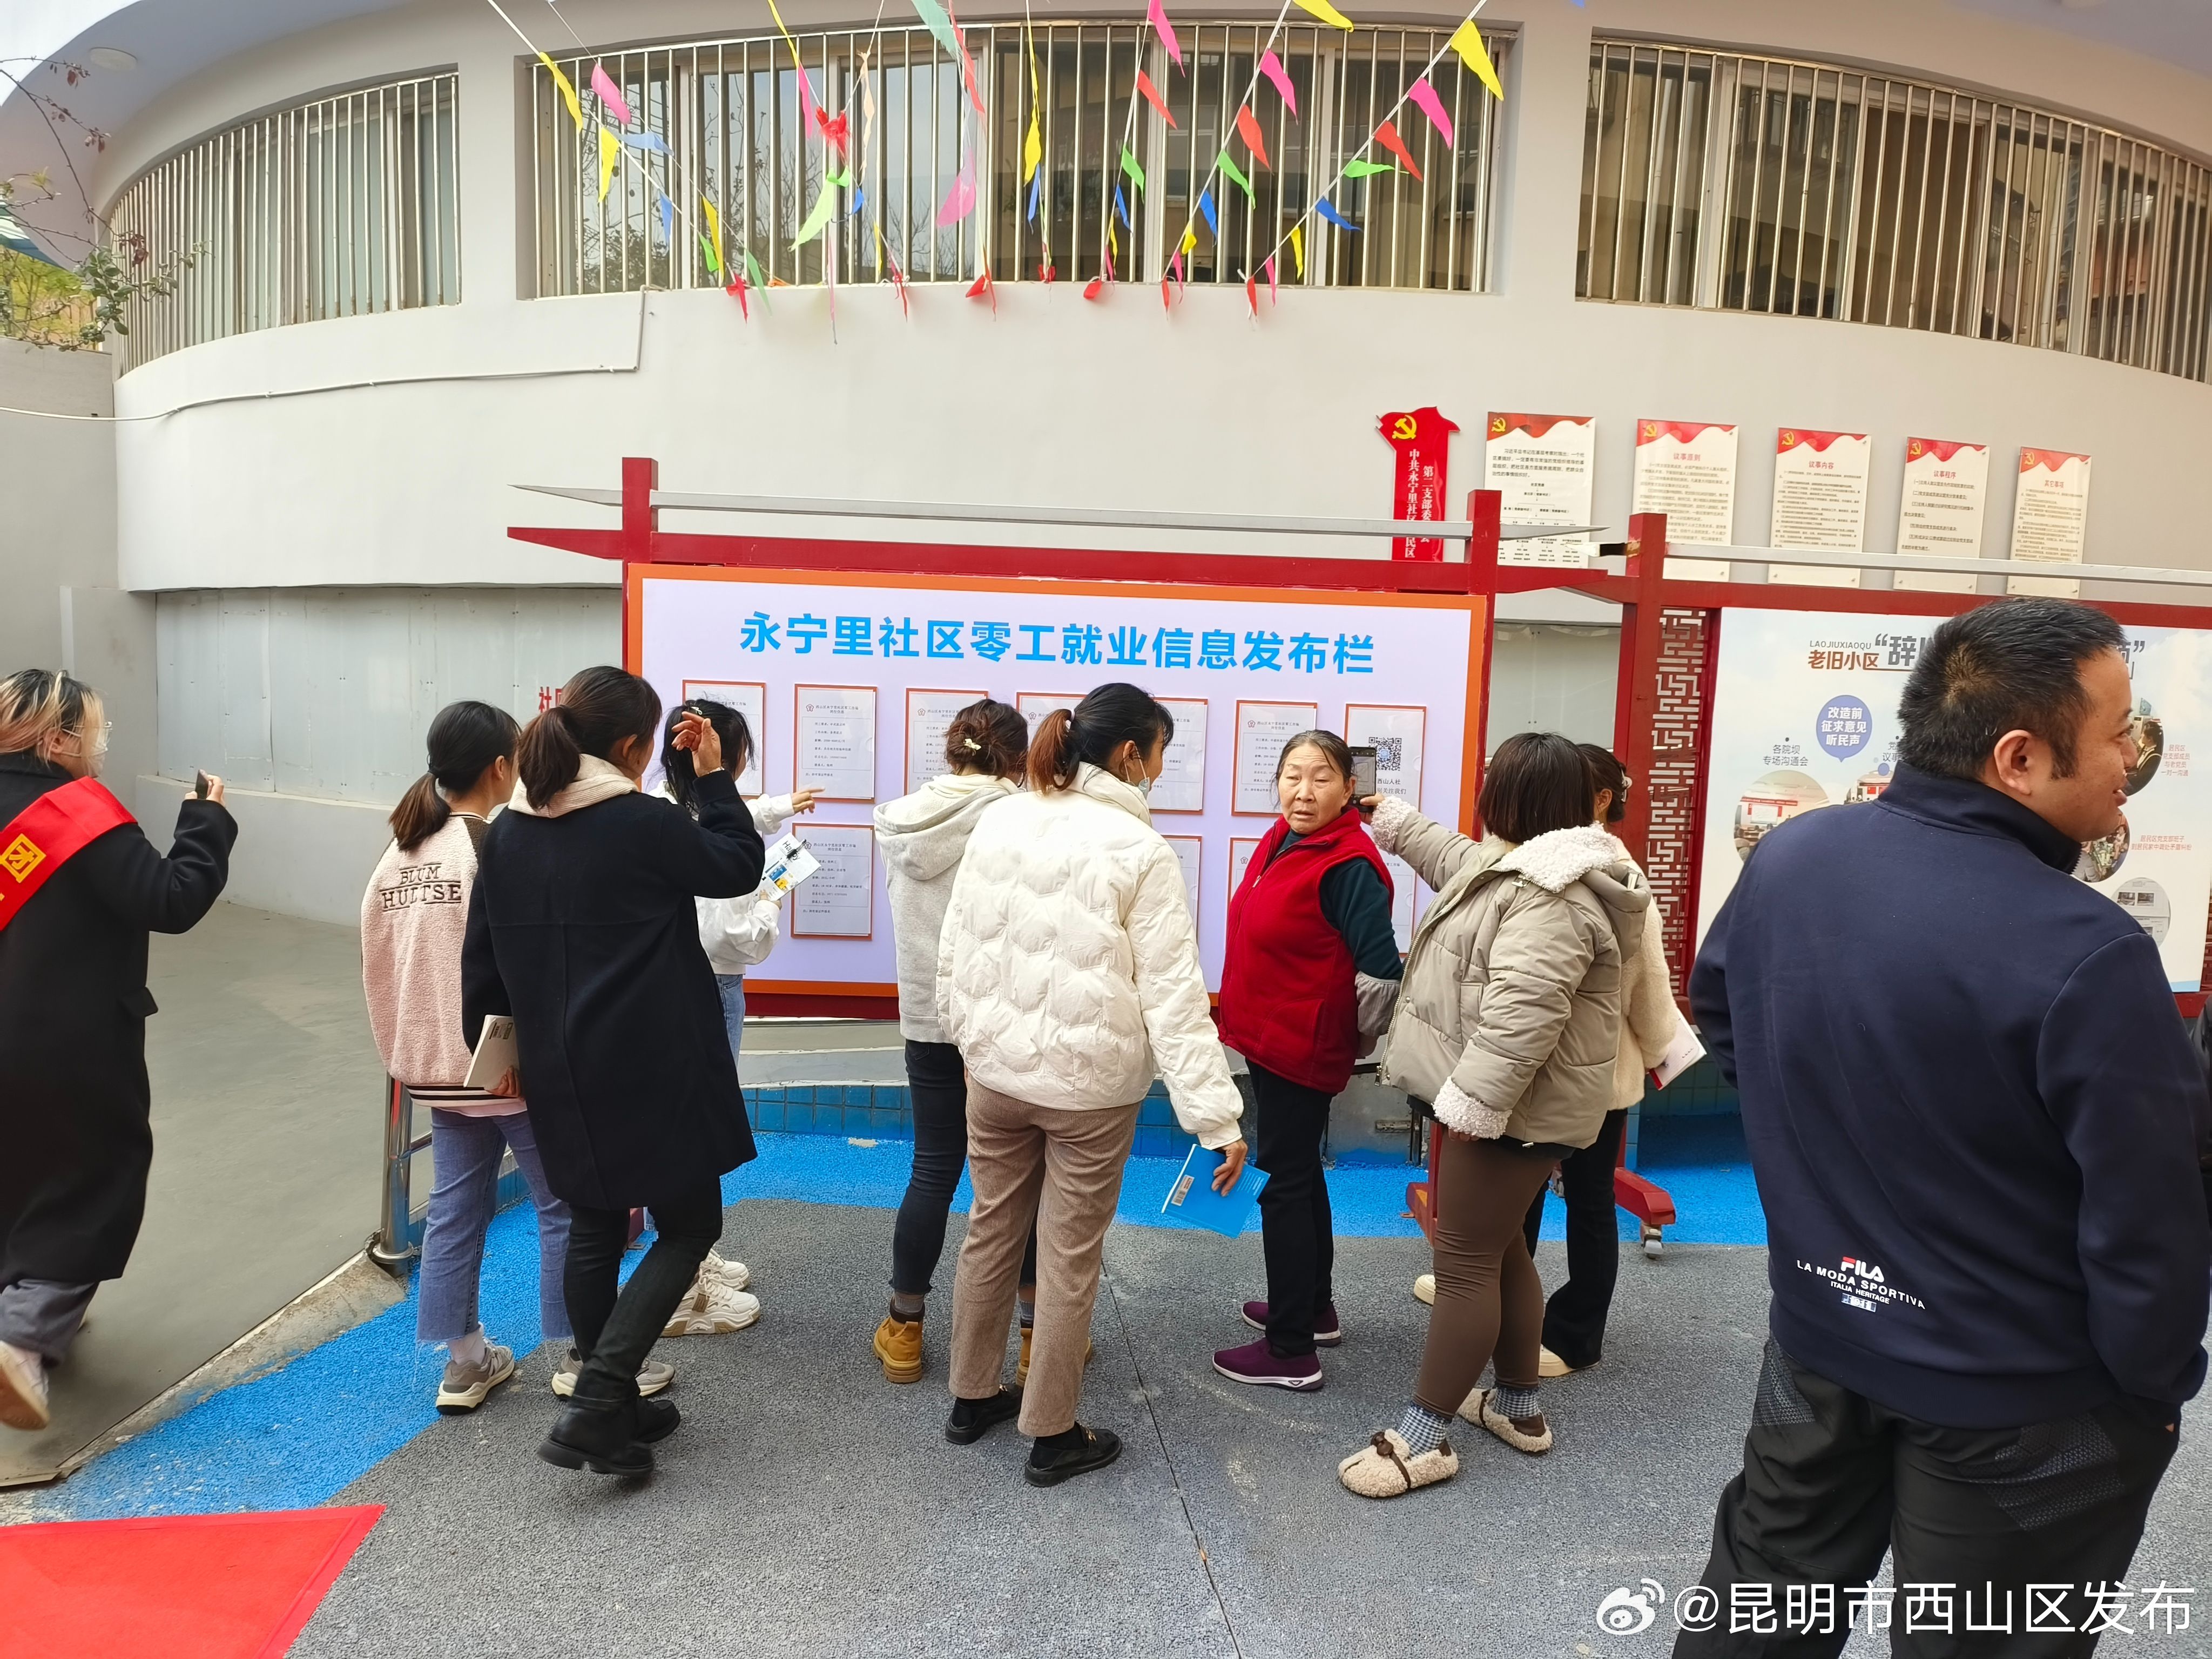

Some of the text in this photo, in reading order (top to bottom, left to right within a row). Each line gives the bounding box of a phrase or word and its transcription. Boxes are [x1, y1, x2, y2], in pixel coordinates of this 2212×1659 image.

[1674, 453, 1701, 461] 议事原则
[1809, 461, 1835, 469] 议事内容
[1934, 470, 1956, 479] 议事程序
[740, 611, 1374, 675] 永宁里社区零工就业信息发布栏
[1810, 640, 1872, 650] LAOJIUXIAOQU
[1808, 650, 1879, 670] 老旧小区
[1828, 707, 1863, 720] 改造前
[1822, 720, 1867, 733] 征求意见
[1826, 734, 1861, 746] 听民声
[1773, 745, 1800, 754] 各院坝
[1763, 756, 1809, 766] 专场沟通会
[399, 866, 441, 885] BLUM
[1840, 1256, 1885, 1283] FILA
[1797, 1259, 1926, 1310] LA MODA SPORTIVA
[1830, 1280, 1890, 1305] ITALIA HERITAGE
